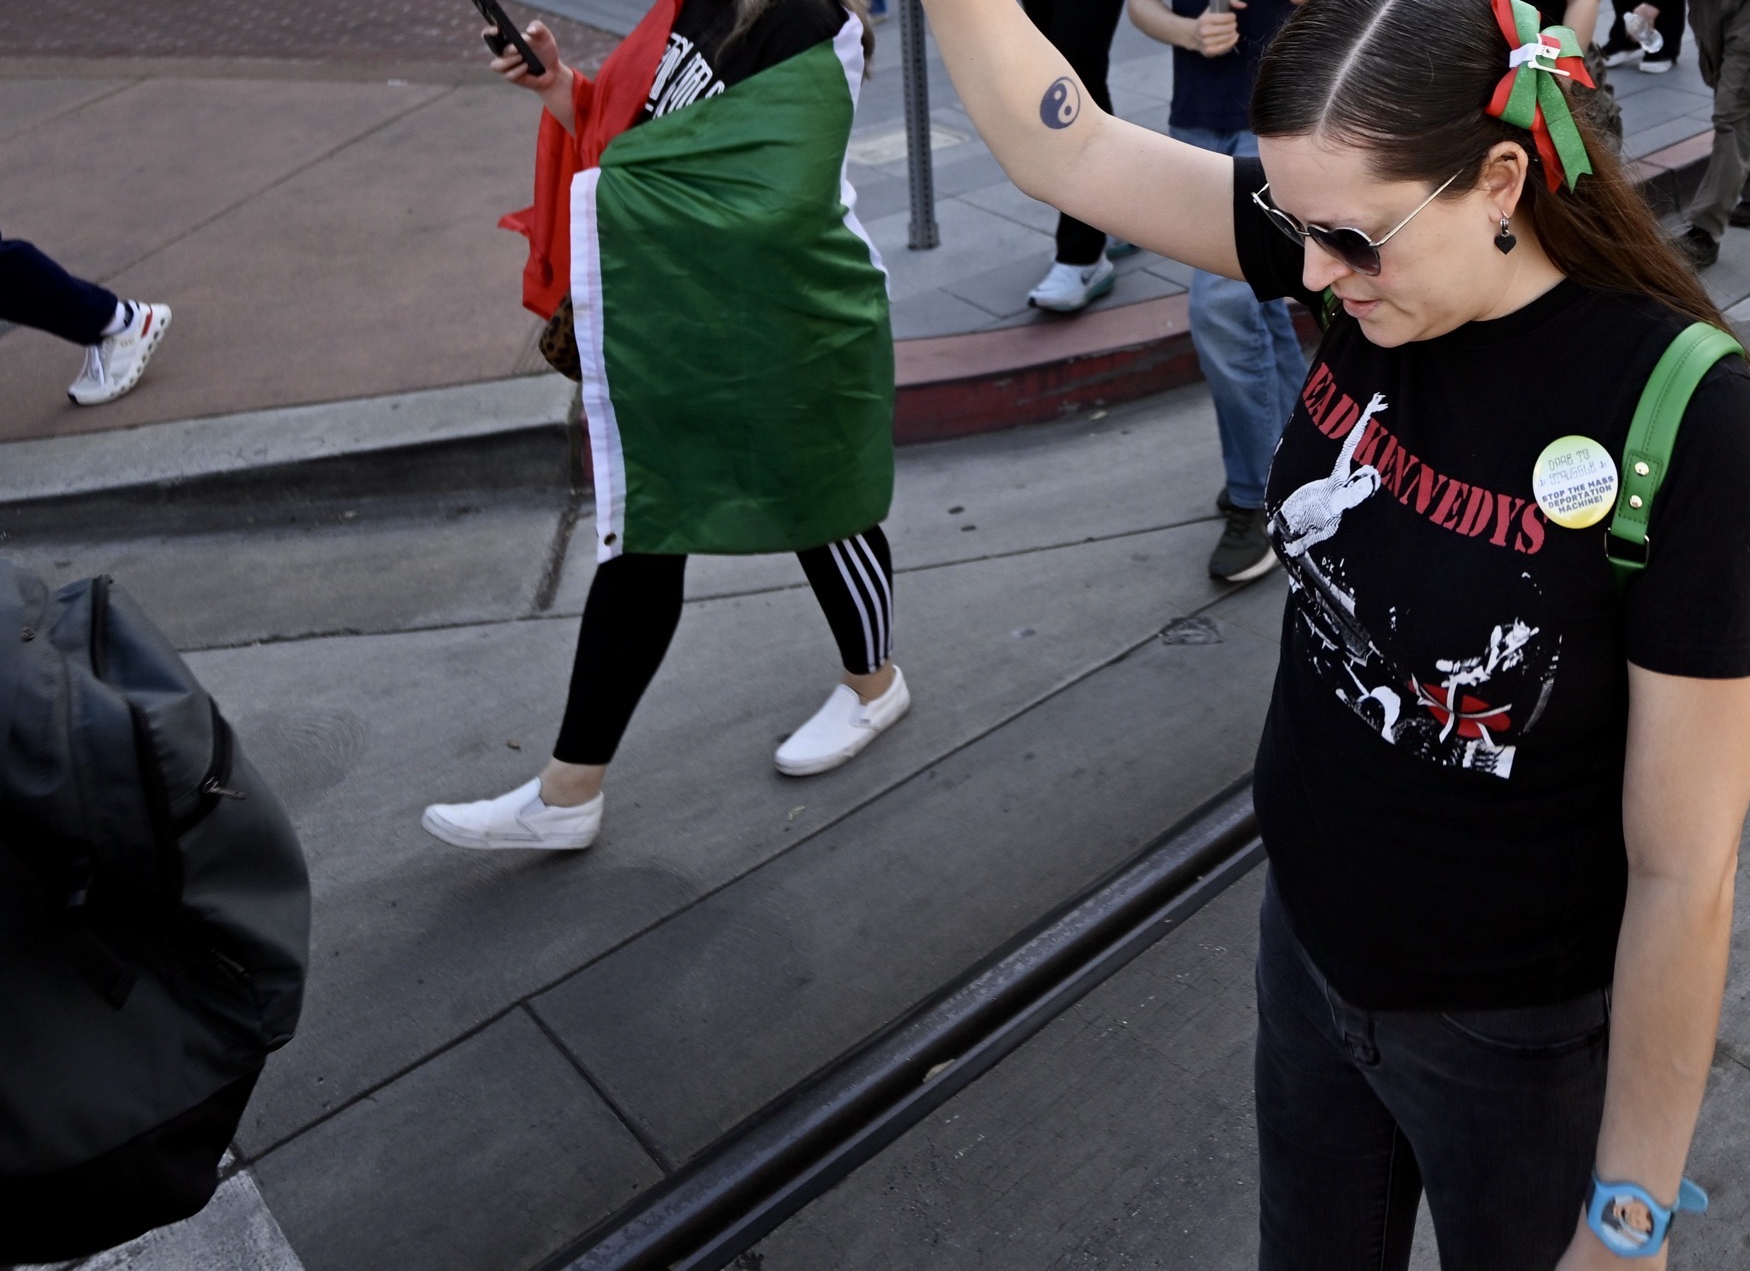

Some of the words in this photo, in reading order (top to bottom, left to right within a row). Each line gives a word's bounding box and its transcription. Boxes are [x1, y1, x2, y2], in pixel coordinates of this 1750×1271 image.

[1302, 361, 1361, 440] EAD
[1542, 490, 1566, 503] STOP
[1567, 484, 1586, 495] THE
[1588, 475, 1614, 488] MASS
[1547, 484, 1612, 509] DEPORTATION
